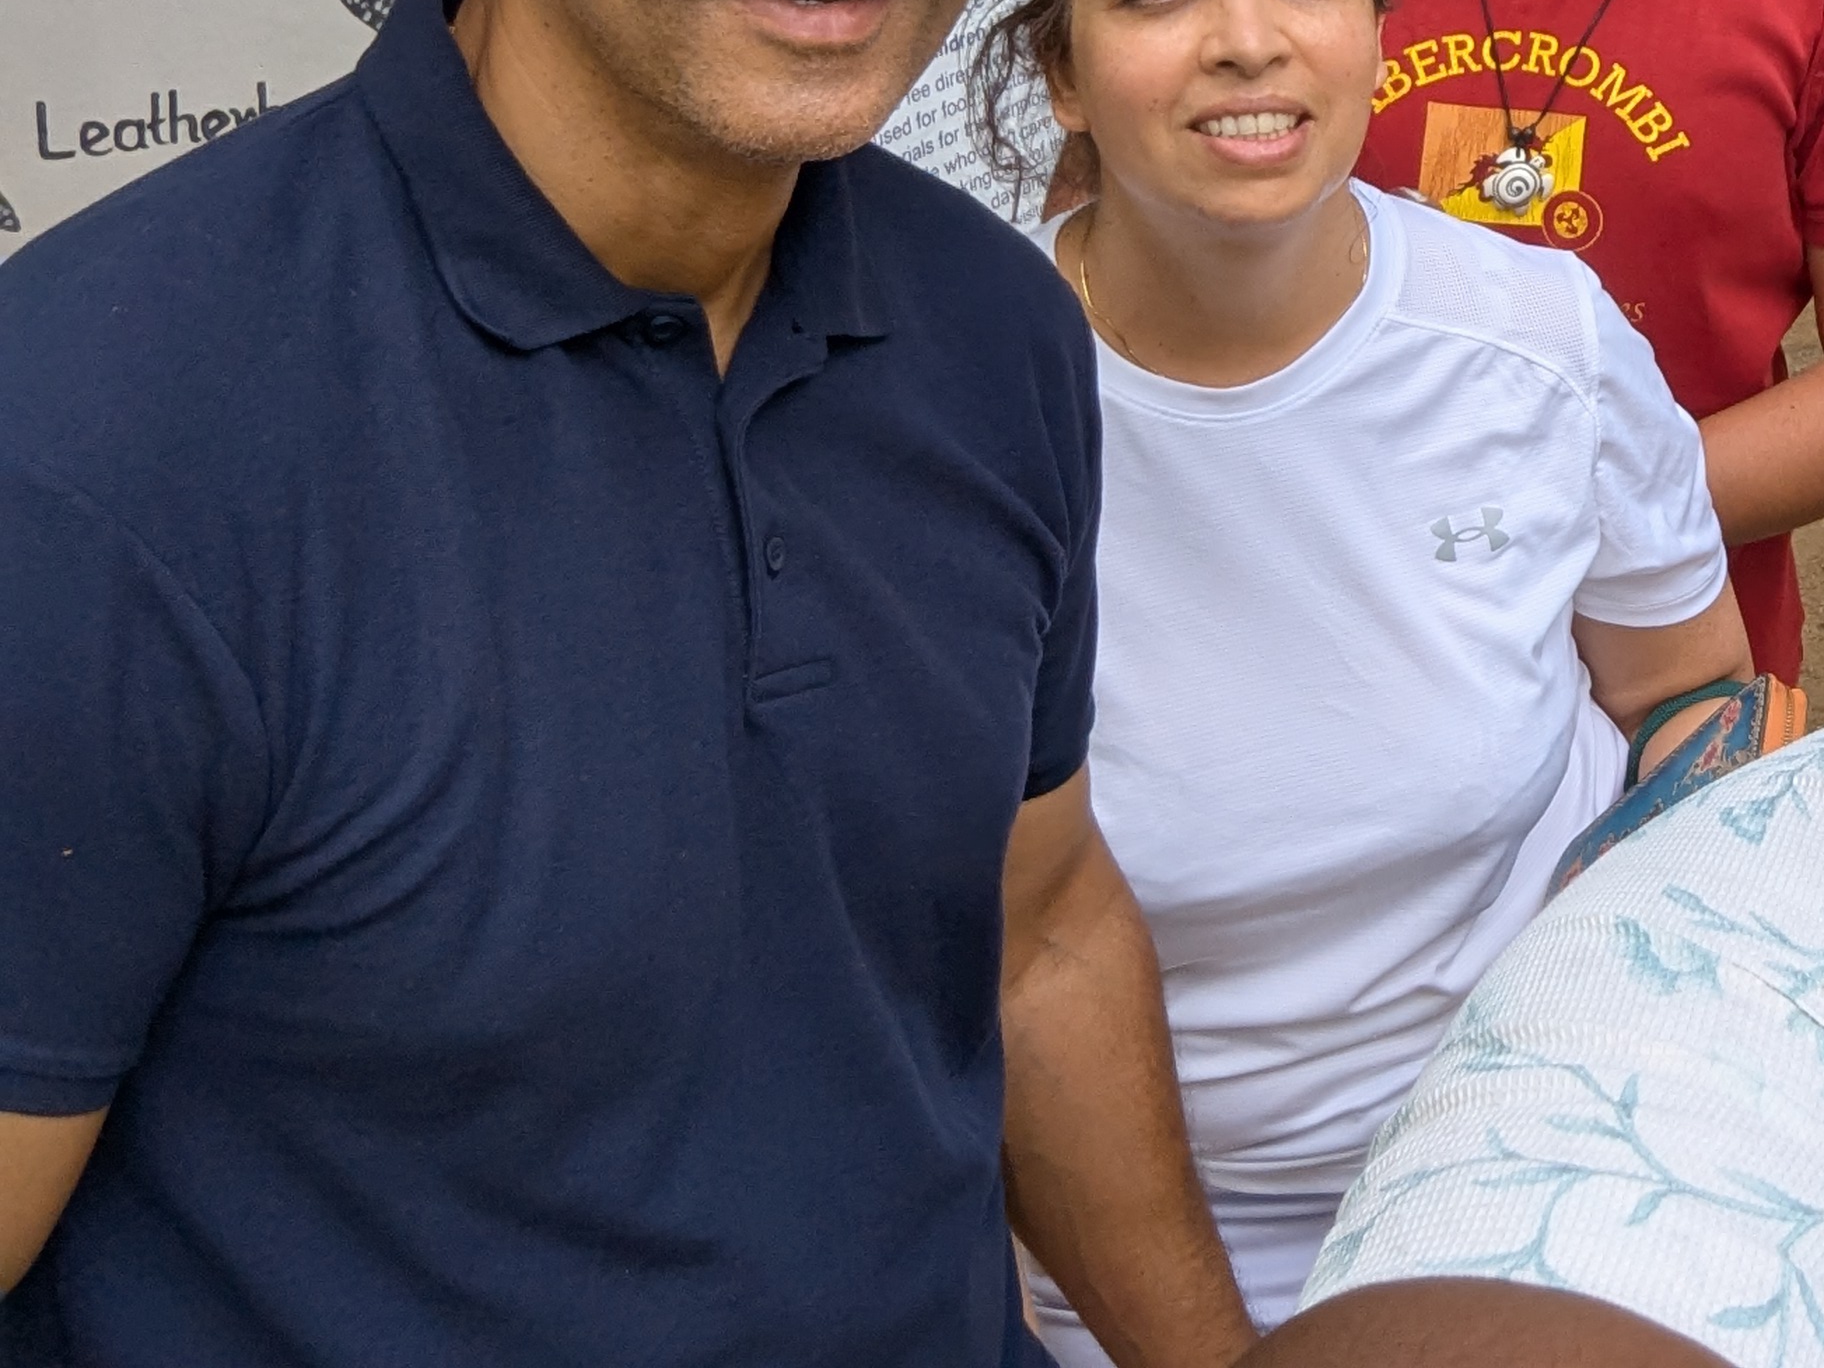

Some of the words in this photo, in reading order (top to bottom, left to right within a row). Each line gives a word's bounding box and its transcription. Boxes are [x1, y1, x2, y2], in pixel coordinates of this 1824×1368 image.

[1371, 30, 1691, 163] BERCROMBI
[916, 109, 937, 130] for
[938, 128, 960, 149] for
[943, 150, 977, 175] who
[959, 169, 992, 192] king
